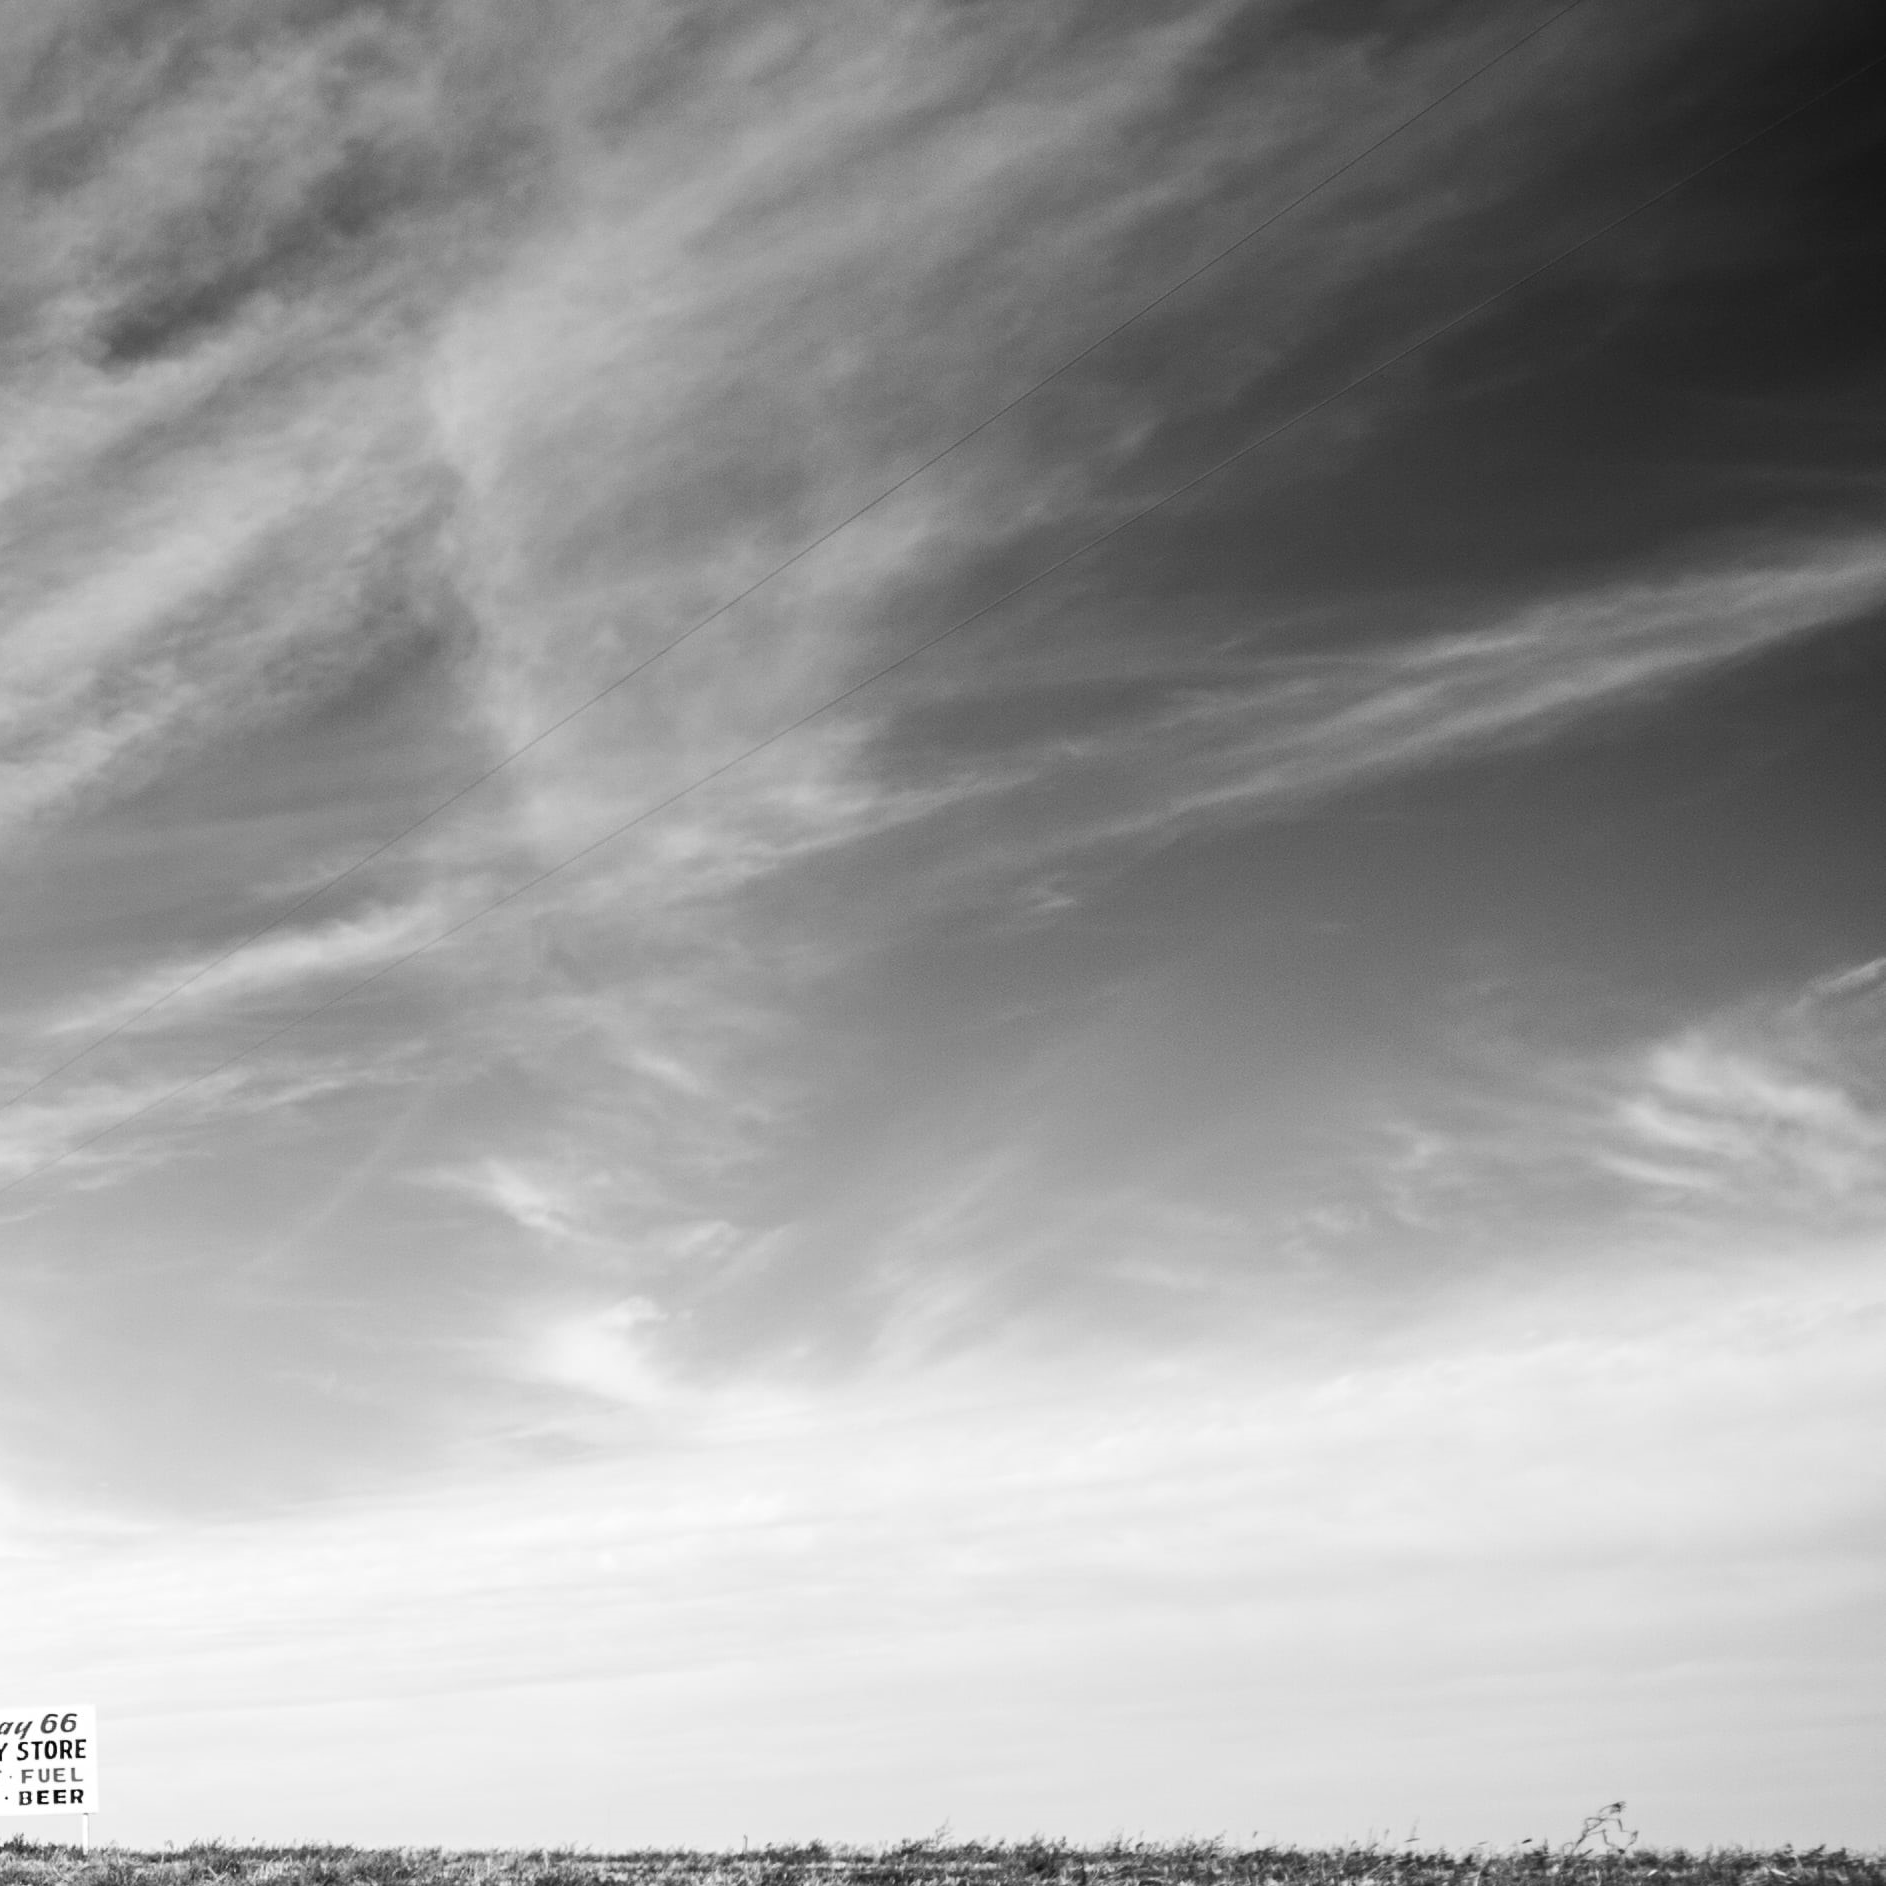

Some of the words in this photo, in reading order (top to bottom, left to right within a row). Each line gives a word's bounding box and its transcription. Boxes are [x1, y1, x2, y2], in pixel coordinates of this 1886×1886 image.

[40, 1713, 78, 1734] 66
[16, 1738, 87, 1761] STORE
[21, 1767, 84, 1784] FUEL
[18, 1788, 84, 1806] BEER
